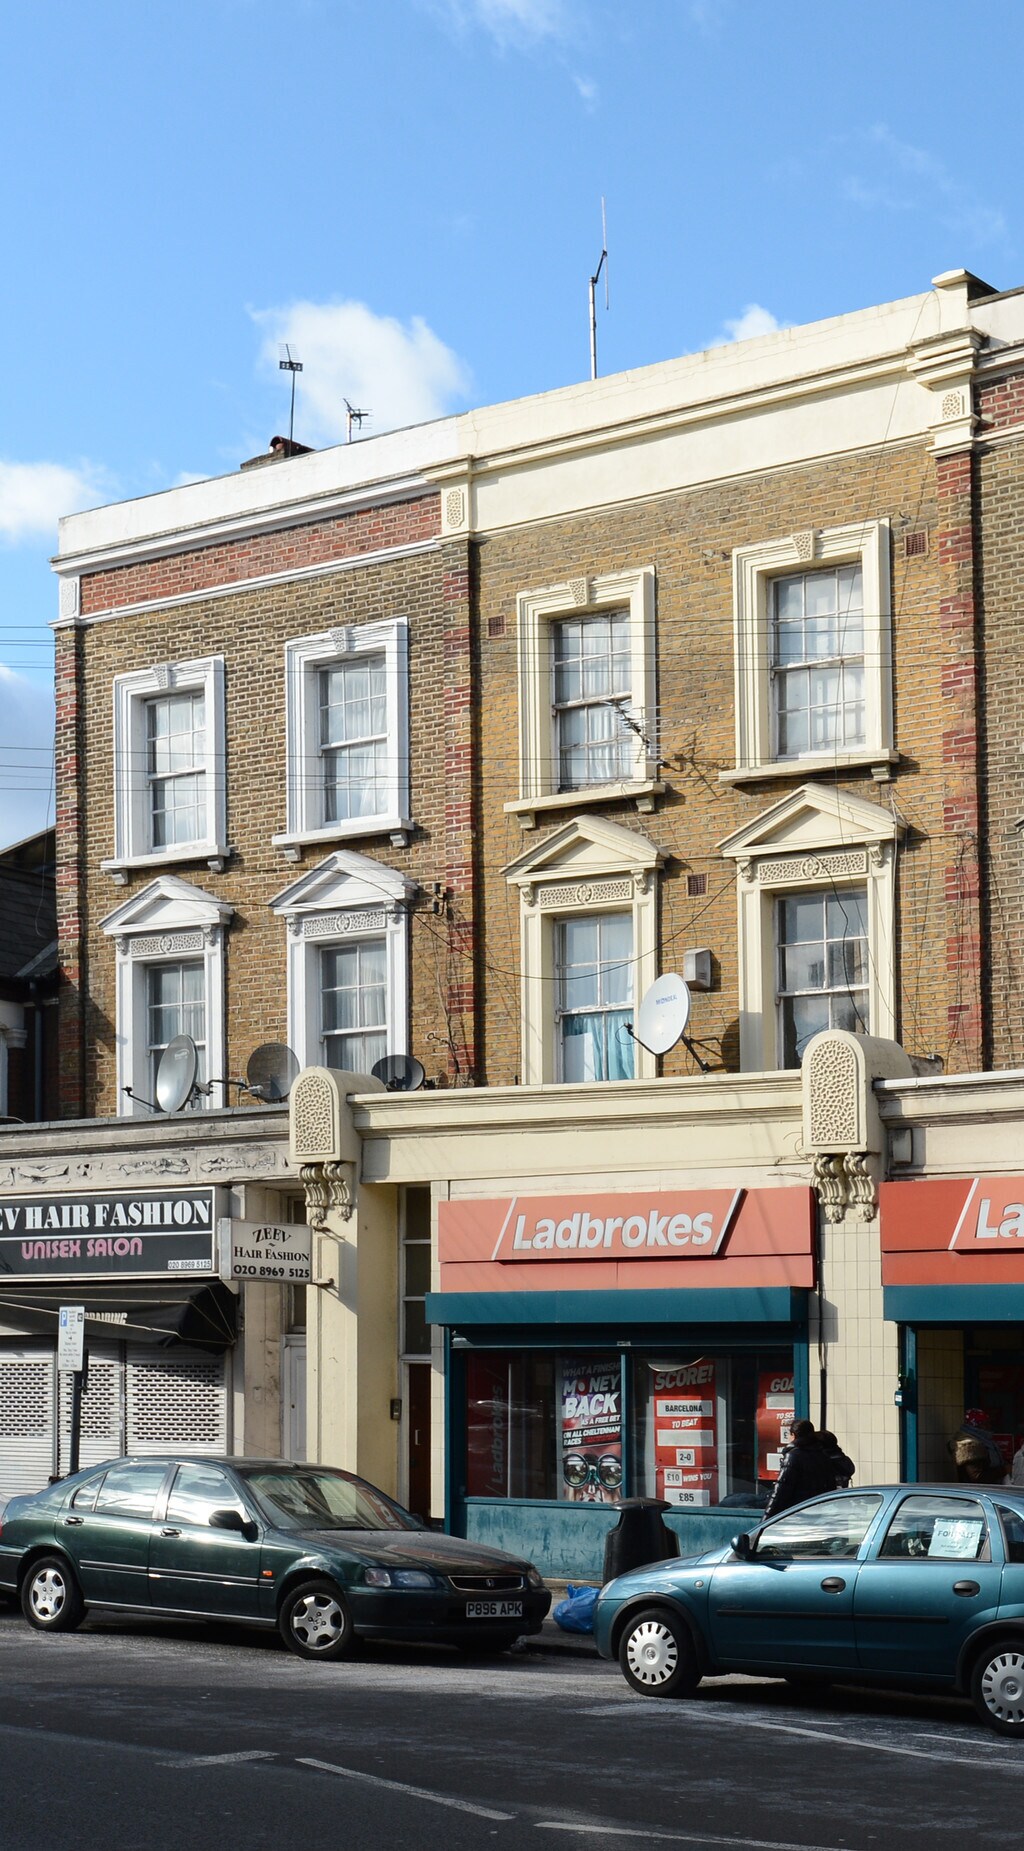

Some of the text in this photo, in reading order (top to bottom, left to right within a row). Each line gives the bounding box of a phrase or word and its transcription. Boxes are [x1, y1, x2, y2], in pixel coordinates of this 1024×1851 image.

[0, 1200, 211, 1230] V HAIR FASHION
[252, 1227, 292, 1244] ZEEV
[513, 1210, 713, 1251] Ladbrokes
[21, 1237, 143, 1260] UNISEX SALON
[234, 1246, 310, 1262] HAIR FASHION
[168, 1259, 211, 1269] 020 8969 5125
[234, 1264, 310, 1278] 020 8969 5125
[655, 1364, 714, 1391] SCORE!
[770, 1377, 794, 1392] GOA
[563, 1374, 621, 1396] MONEY
[563, 1391, 620, 1419] BACK
[665, 1404, 703, 1413] BARCELONA
[786, 1411, 795, 1420] SCO
[672, 1418, 698, 1429] TO BEAT
[563, 1430, 572, 1440] ON
[572, 1429, 583, 1439] ALL
[583, 1425, 621, 1436] CHELTENHAM
[563, 1437, 583, 1446] RACES
[679, 1453, 692, 1461] 2-0
[666, 1472, 712, 1482] £10 WINS YOU
[679, 1493, 695, 1502] £85
[467, 1602, 522, 1616] P896 APK
